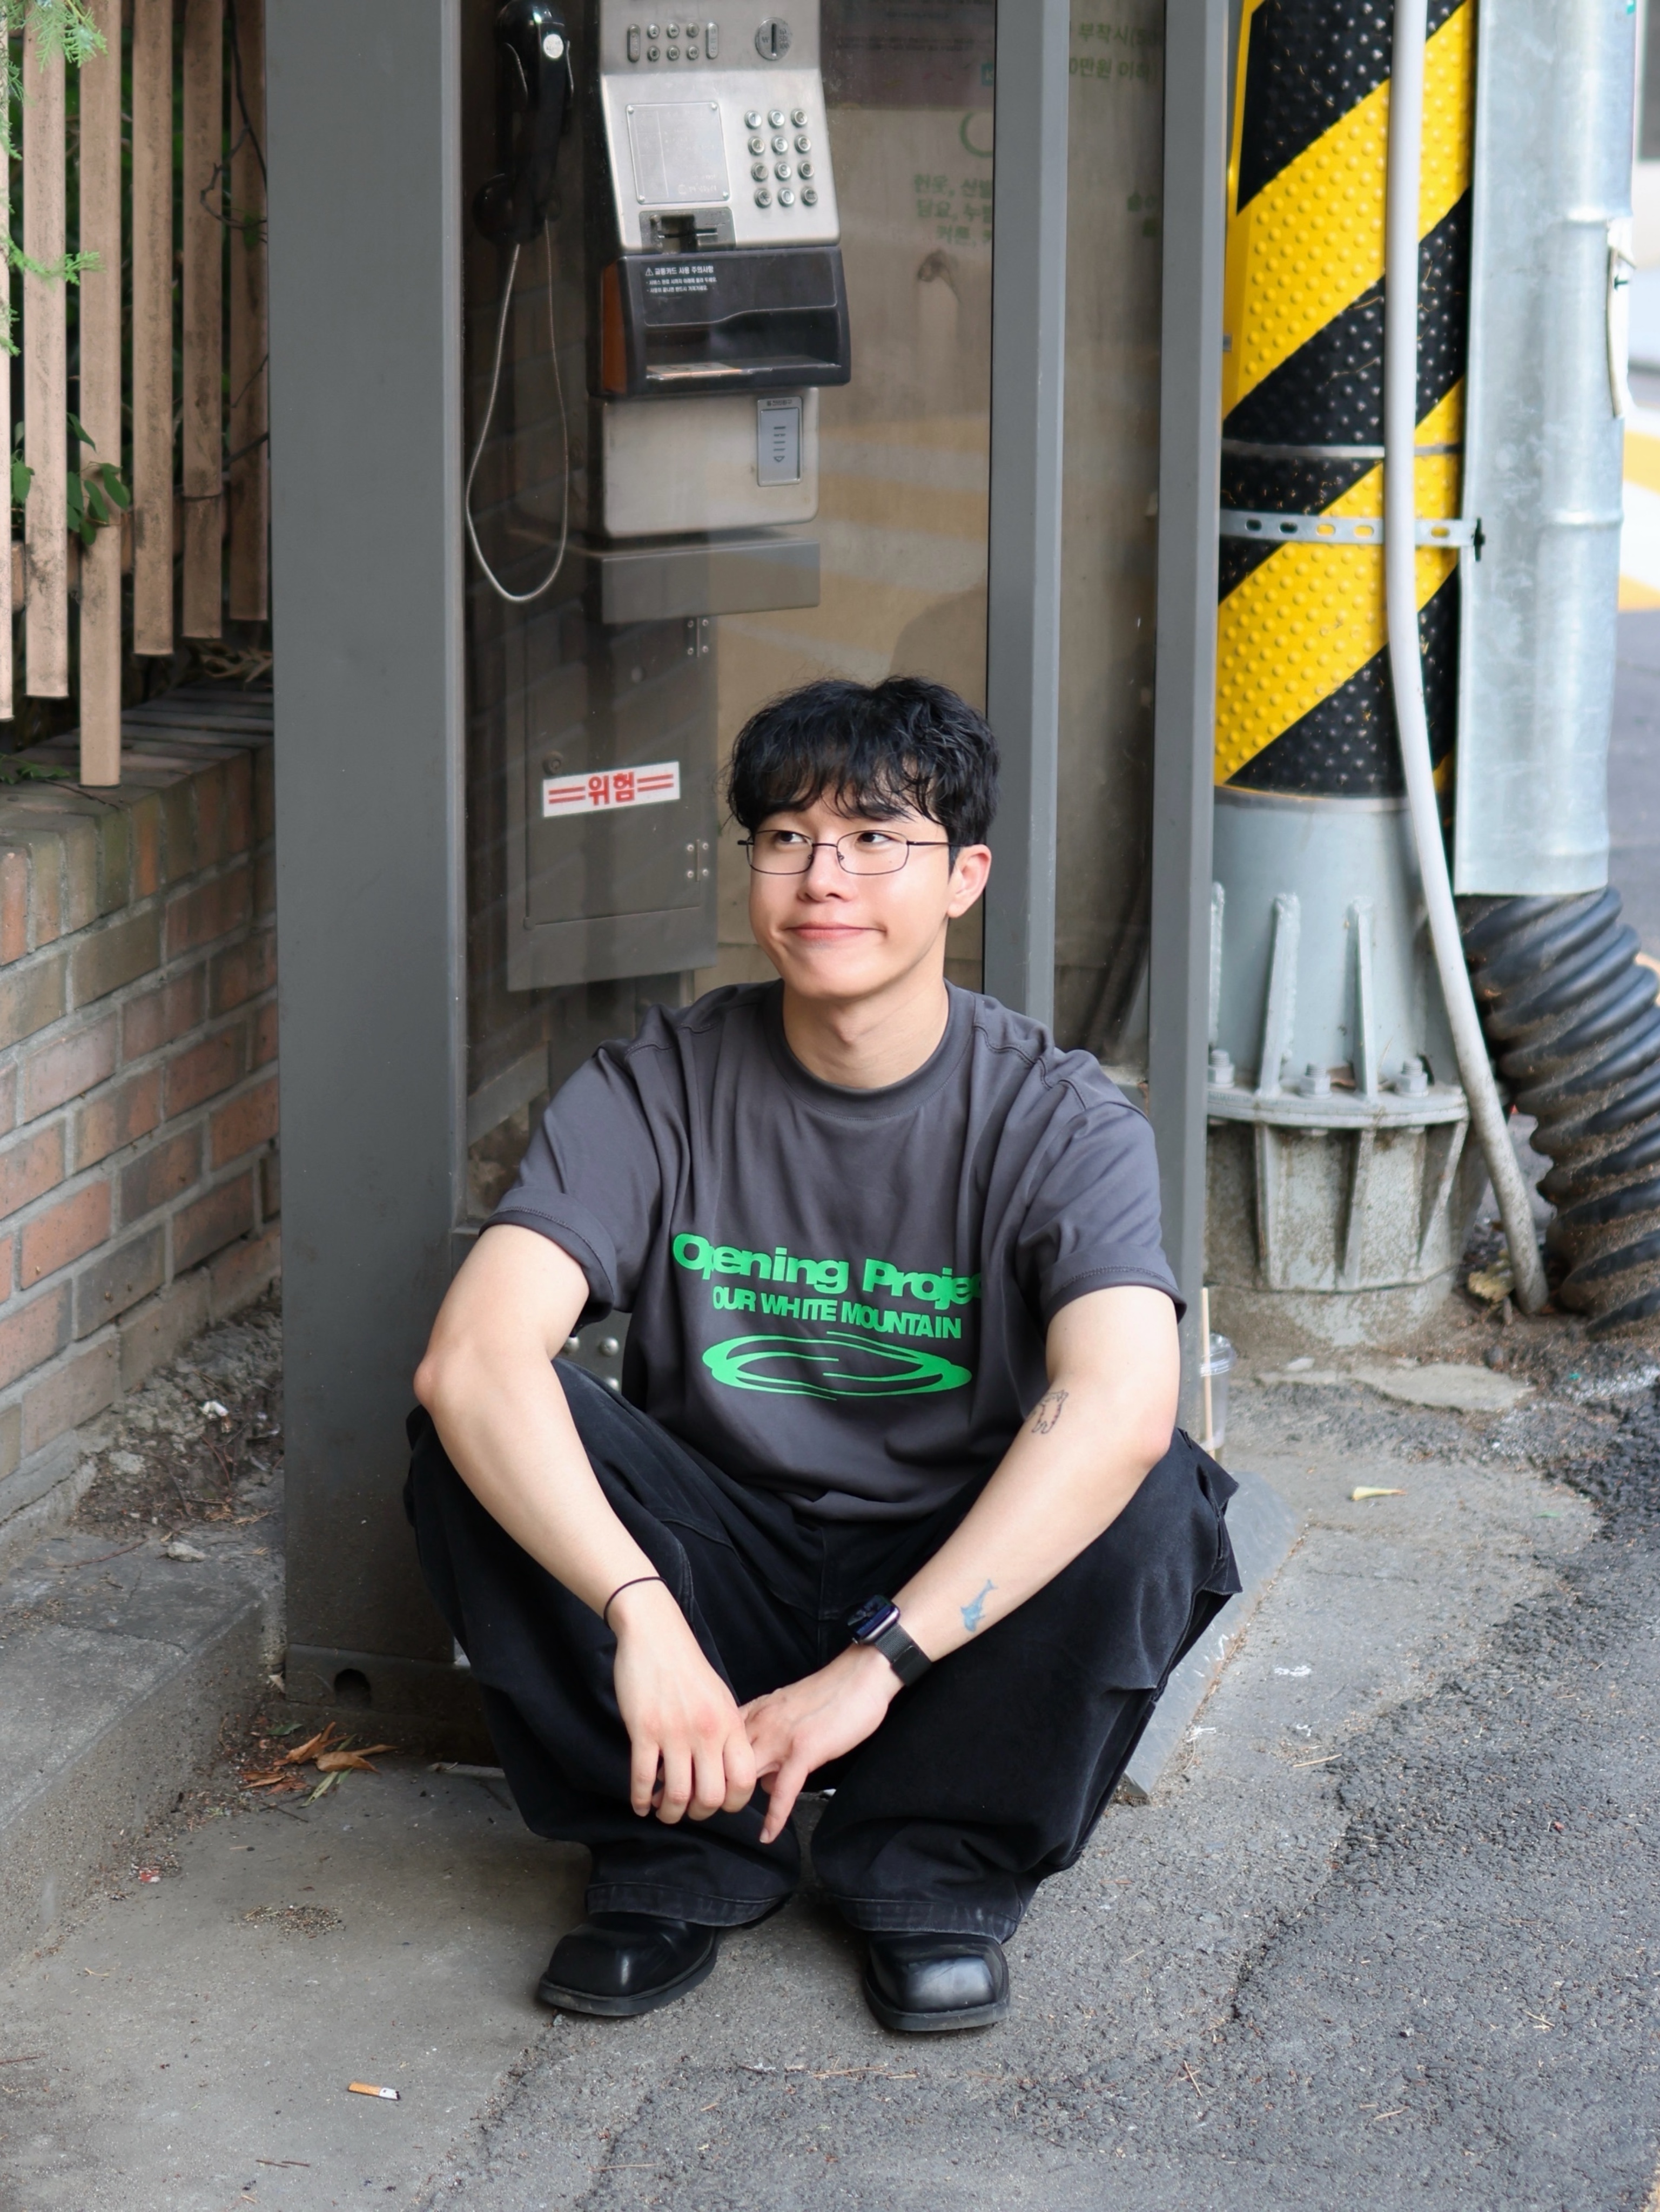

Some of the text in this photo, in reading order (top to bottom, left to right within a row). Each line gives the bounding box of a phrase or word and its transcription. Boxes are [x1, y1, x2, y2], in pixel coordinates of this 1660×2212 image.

[655, 265, 714, 275] 교통카드 사용 주의사항
[588, 772, 635, 806] 위험
[673, 1233, 849, 1294] Opening
[713, 1286, 962, 1339] OUR WHITE MOUNTAIN
